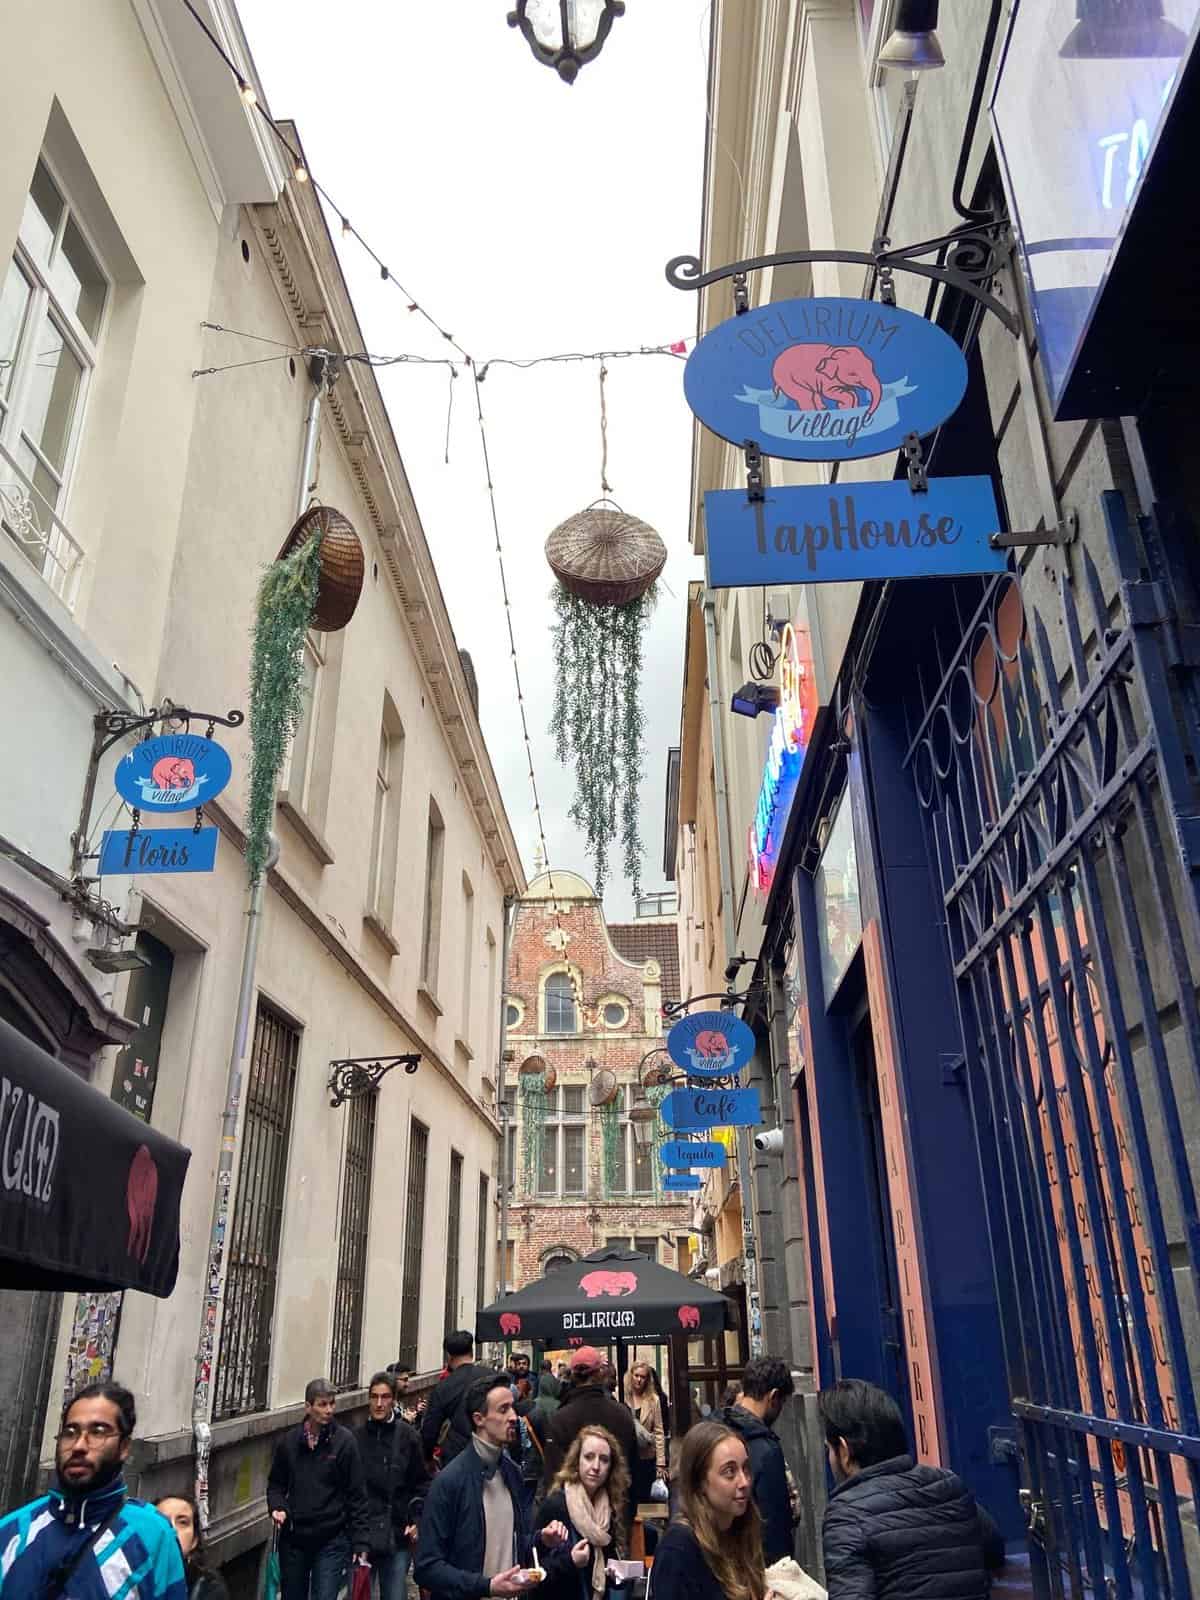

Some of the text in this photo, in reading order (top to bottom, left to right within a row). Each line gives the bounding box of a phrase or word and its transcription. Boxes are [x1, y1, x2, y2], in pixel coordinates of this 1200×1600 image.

[737, 304, 901, 358] DELIRIUM
[787, 412, 874, 447] Village
[744, 496, 962, 571] TapHouse
[141, 738, 210, 761] DELIRIUM
[151, 790, 188, 807] Village
[122, 833, 189, 867] Floris
[693, 1095, 737, 1122] Café
[563, 1311, 635, 1329] DELIRIUM
